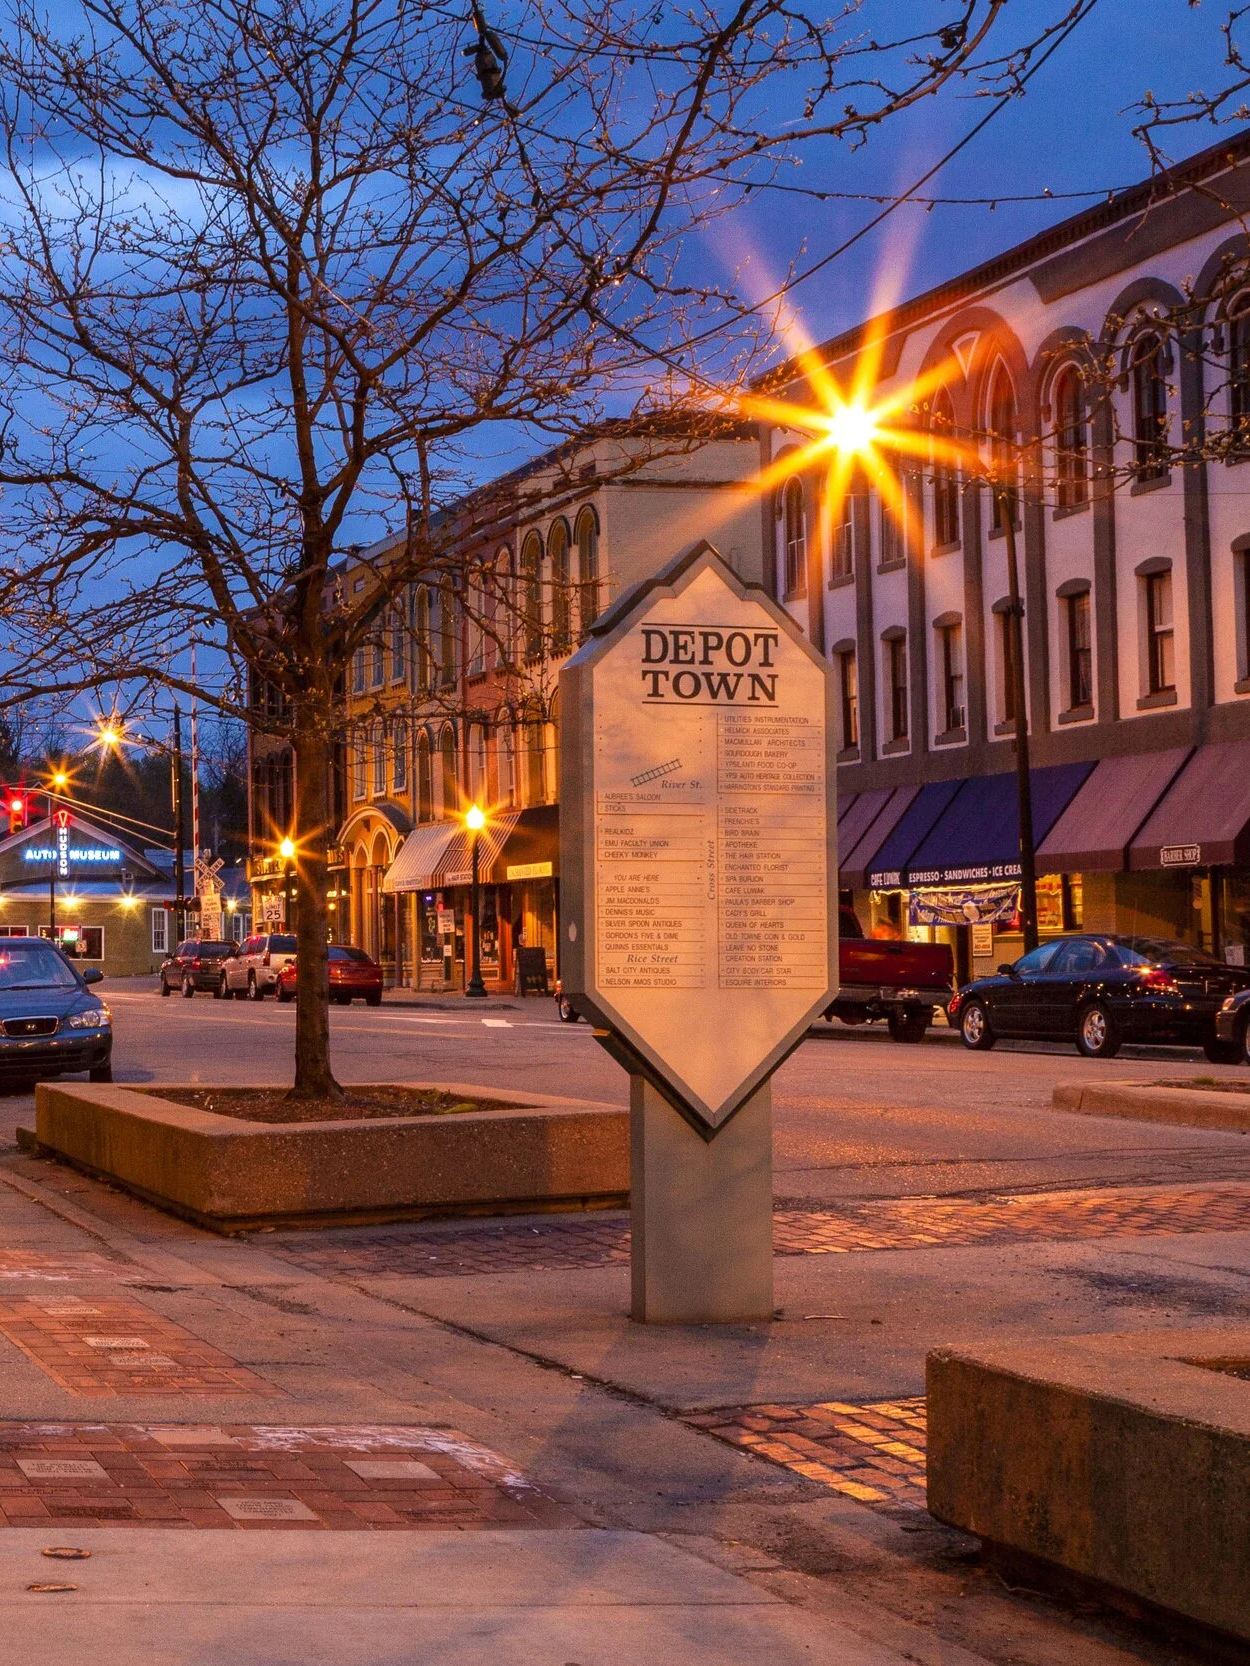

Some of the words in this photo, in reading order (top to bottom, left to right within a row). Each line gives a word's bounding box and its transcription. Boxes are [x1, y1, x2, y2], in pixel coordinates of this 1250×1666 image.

[641, 629, 778, 668] DEPOT
[641, 670, 779, 701] TOWN
[724, 715, 752, 723] UTILITIES
[755, 716, 809, 724] INSTRUMENTATION
[724, 738, 762, 746] MACMULLAN
[782, 773, 815, 781] COLLECTION
[661, 780, 686, 789] River
[690, 780, 703, 789] St.
[636, 793, 661, 801] SALOON
[25, 849, 57, 861] AUTO
[69, 849, 120, 861] MUSEUM
[59, 827, 68, 876] HUDSON
[707, 840, 716, 869] Street
[725, 852, 738, 860] THE
[739, 852, 754, 860] HAIR
[756, 852, 781, 860] STATION
[1183, 848, 1197, 861] SHOP
[909, 871, 939, 883] ESPRESSO
[944, 867, 988, 880] SANDWICHES
[992, 866, 1003, 876] ICE
[1004, 864, 1022, 876] CREA
[870, 873, 883, 886] CAFE
[707, 871, 716, 900] Cross
[266, 910, 281, 920] 25
[725, 921, 747, 929] QUEEN
[749, 921, 758, 929] OF
[759, 921, 784, 929] HEARTS
[641, 932, 655, 940] FIVE
[663, 932, 679, 940] DIME
[725, 933, 738, 941] OLD
[764, 933, 779, 941] COIN
[788, 933, 805, 941] GOLD
[627, 954, 647, 963] Rice
[651, 954, 678, 963] Street
